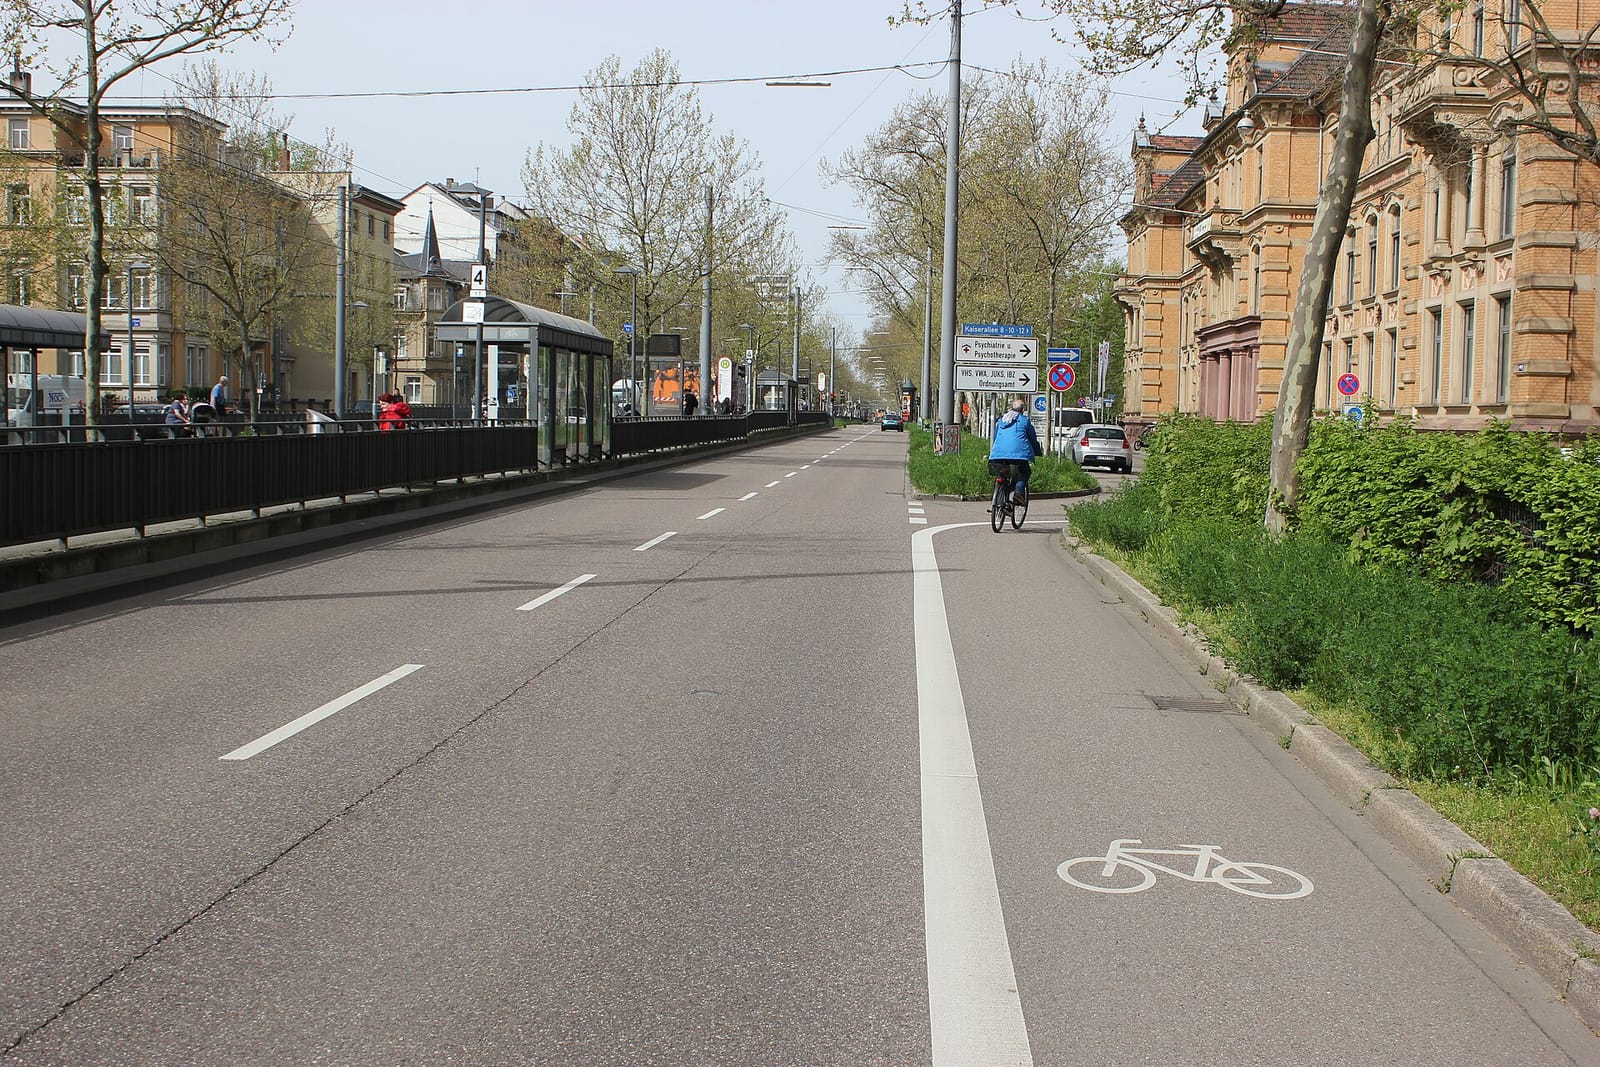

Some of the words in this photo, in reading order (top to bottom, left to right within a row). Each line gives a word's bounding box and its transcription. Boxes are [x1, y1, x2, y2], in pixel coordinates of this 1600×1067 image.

[474, 269, 483, 285] 4
[964, 325, 999, 333] Kaiserallee
[1000, 326, 1005, 334] 8
[975, 341, 1005, 349] Psychiatrie
[975, 350, 1016, 360] Psychotherapie
[1006, 371, 1015, 379] IBZ
[979, 379, 1015, 390] Ordnungsamt
